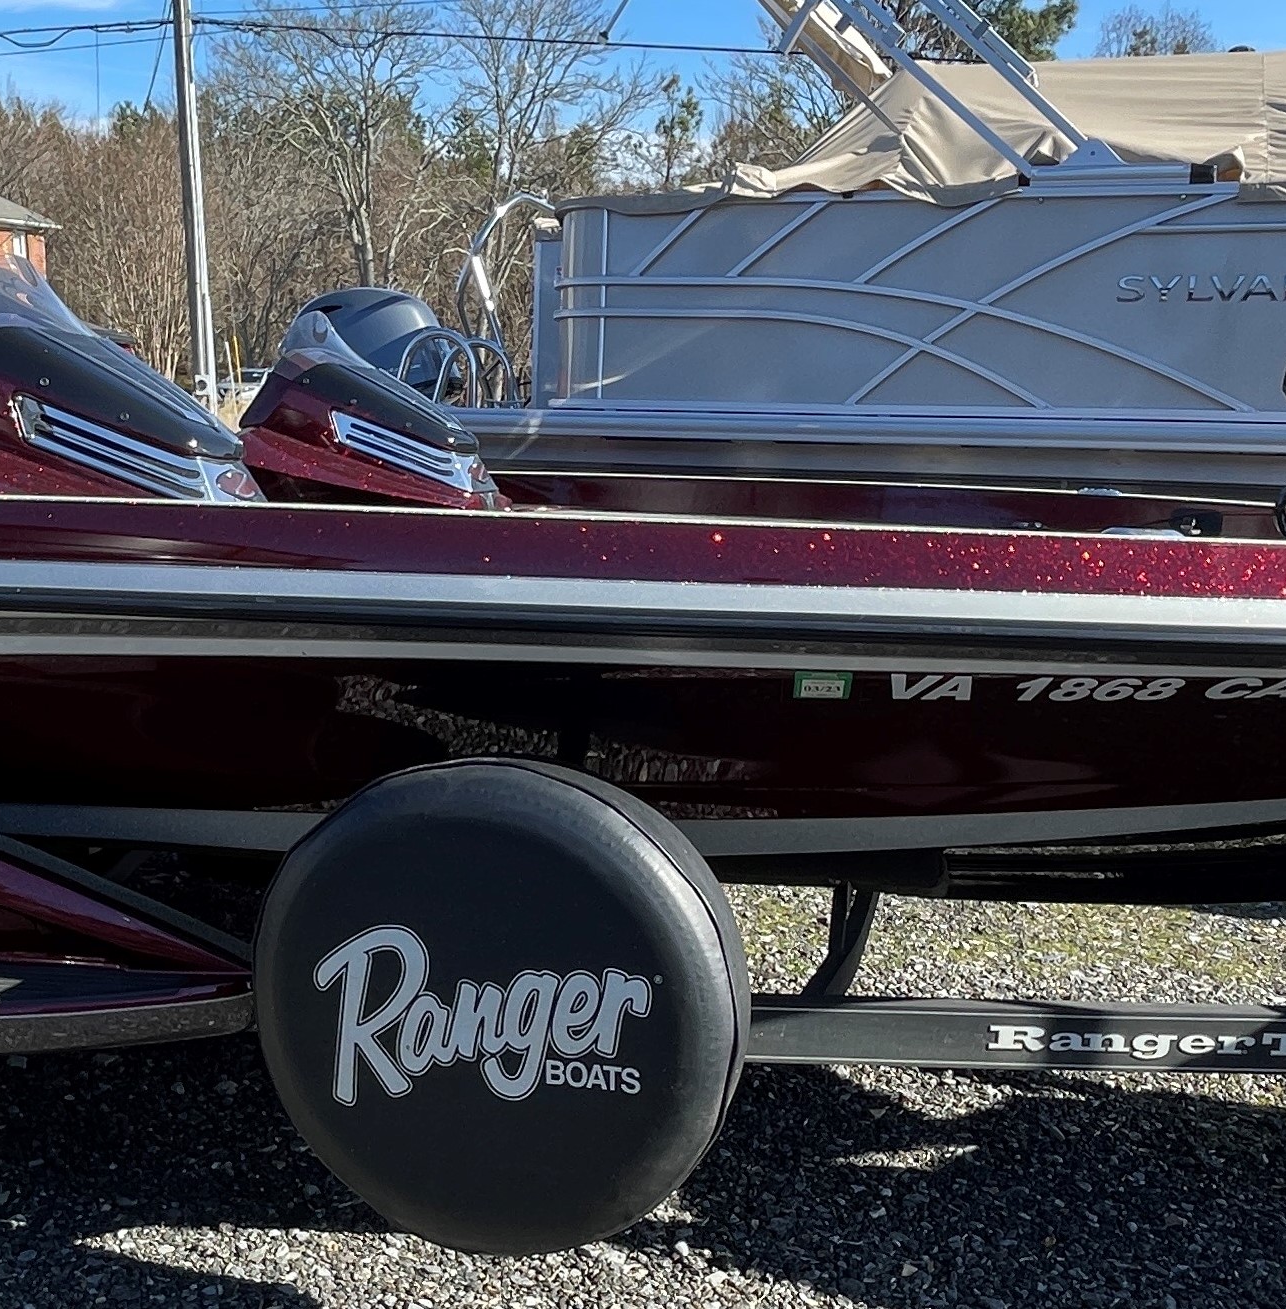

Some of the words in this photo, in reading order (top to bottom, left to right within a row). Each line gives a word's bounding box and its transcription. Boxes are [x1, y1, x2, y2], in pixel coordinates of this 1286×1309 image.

[890, 673, 973, 700] VA
[1016, 676, 1186, 701] 1868
[313, 924, 653, 1106] Ranger
[544, 1058, 642, 1095] BOATS
